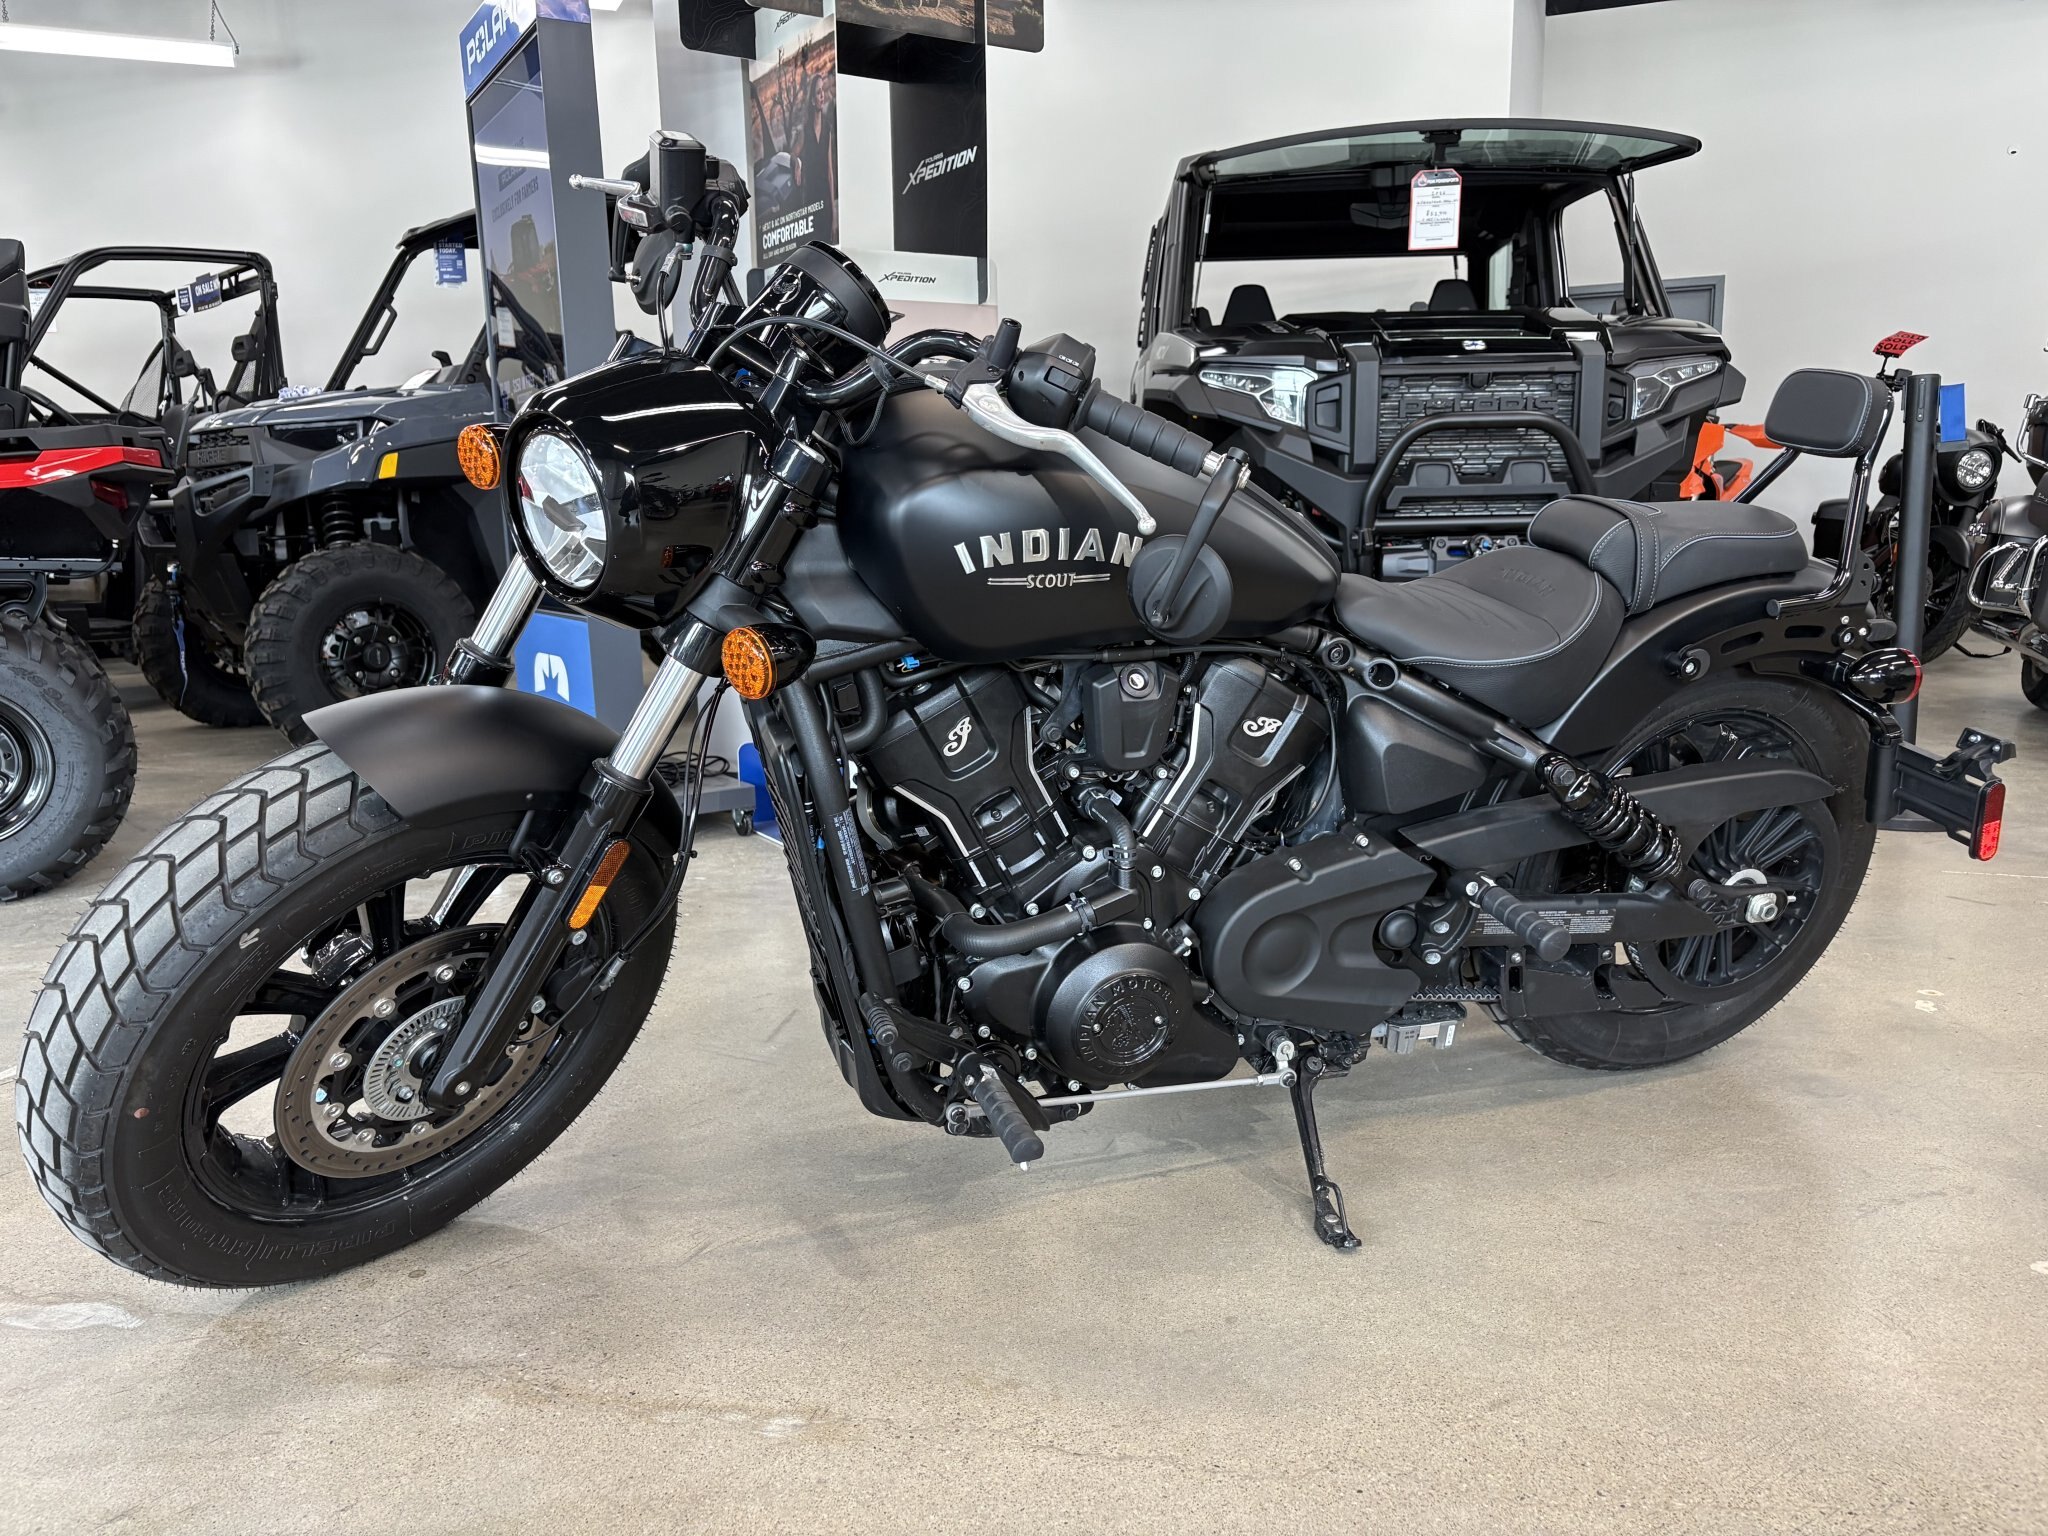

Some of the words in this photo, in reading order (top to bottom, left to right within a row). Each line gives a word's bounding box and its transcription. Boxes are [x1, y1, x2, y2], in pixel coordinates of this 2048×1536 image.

[902, 145, 978, 195] XPEDITION
[807, 200, 824, 214] MODELS
[762, 215, 814, 250] COMFORTABLE
[878, 271, 937, 284] XPEDITION
[1877, 343, 1908, 351] SOLD
[953, 527, 1144, 575] INDIAN
[1026, 572, 1077, 589] SCOUT
